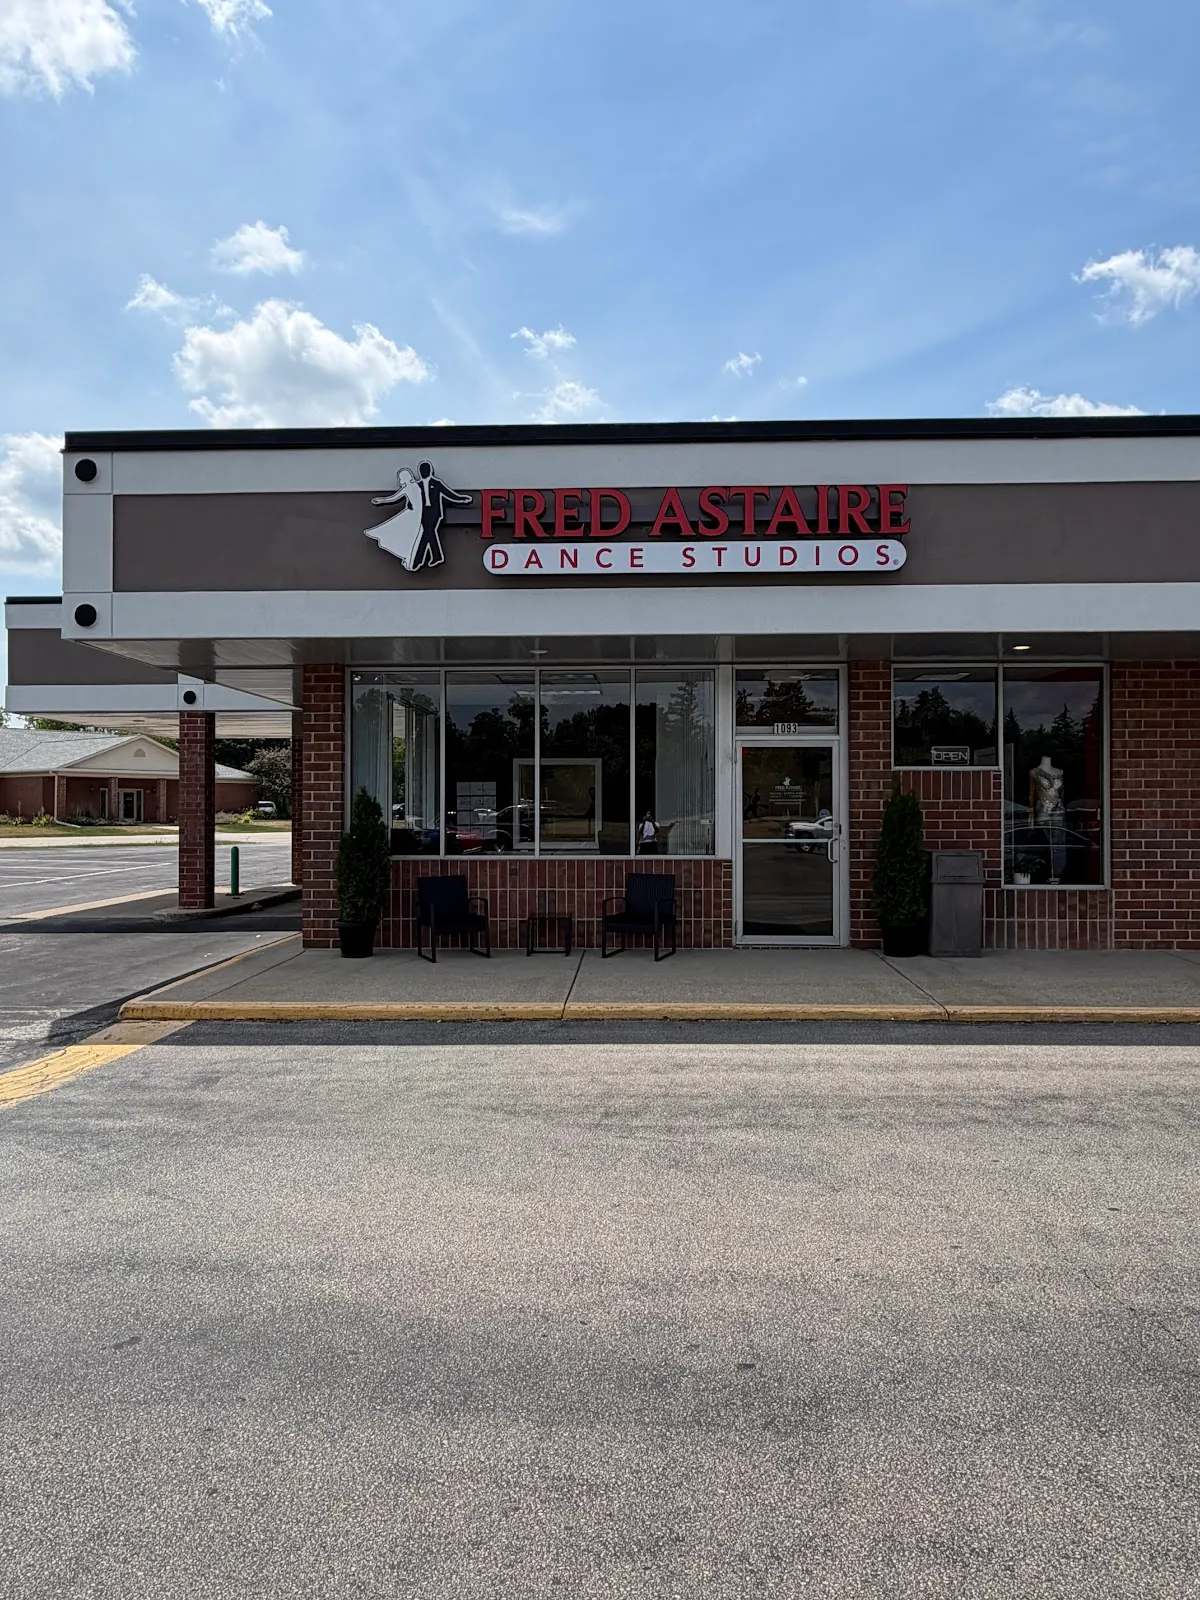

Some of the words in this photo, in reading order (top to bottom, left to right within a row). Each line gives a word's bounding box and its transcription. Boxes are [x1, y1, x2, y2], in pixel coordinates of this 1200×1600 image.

[480, 487, 632, 539] FRED
[650, 483, 911, 536] ASTAIRE
[491, 548, 645, 570] DANCE
[683, 544, 891, 568] STUDIOS
[775, 723, 797, 734] 1093
[933, 751, 968, 761] OPEN
